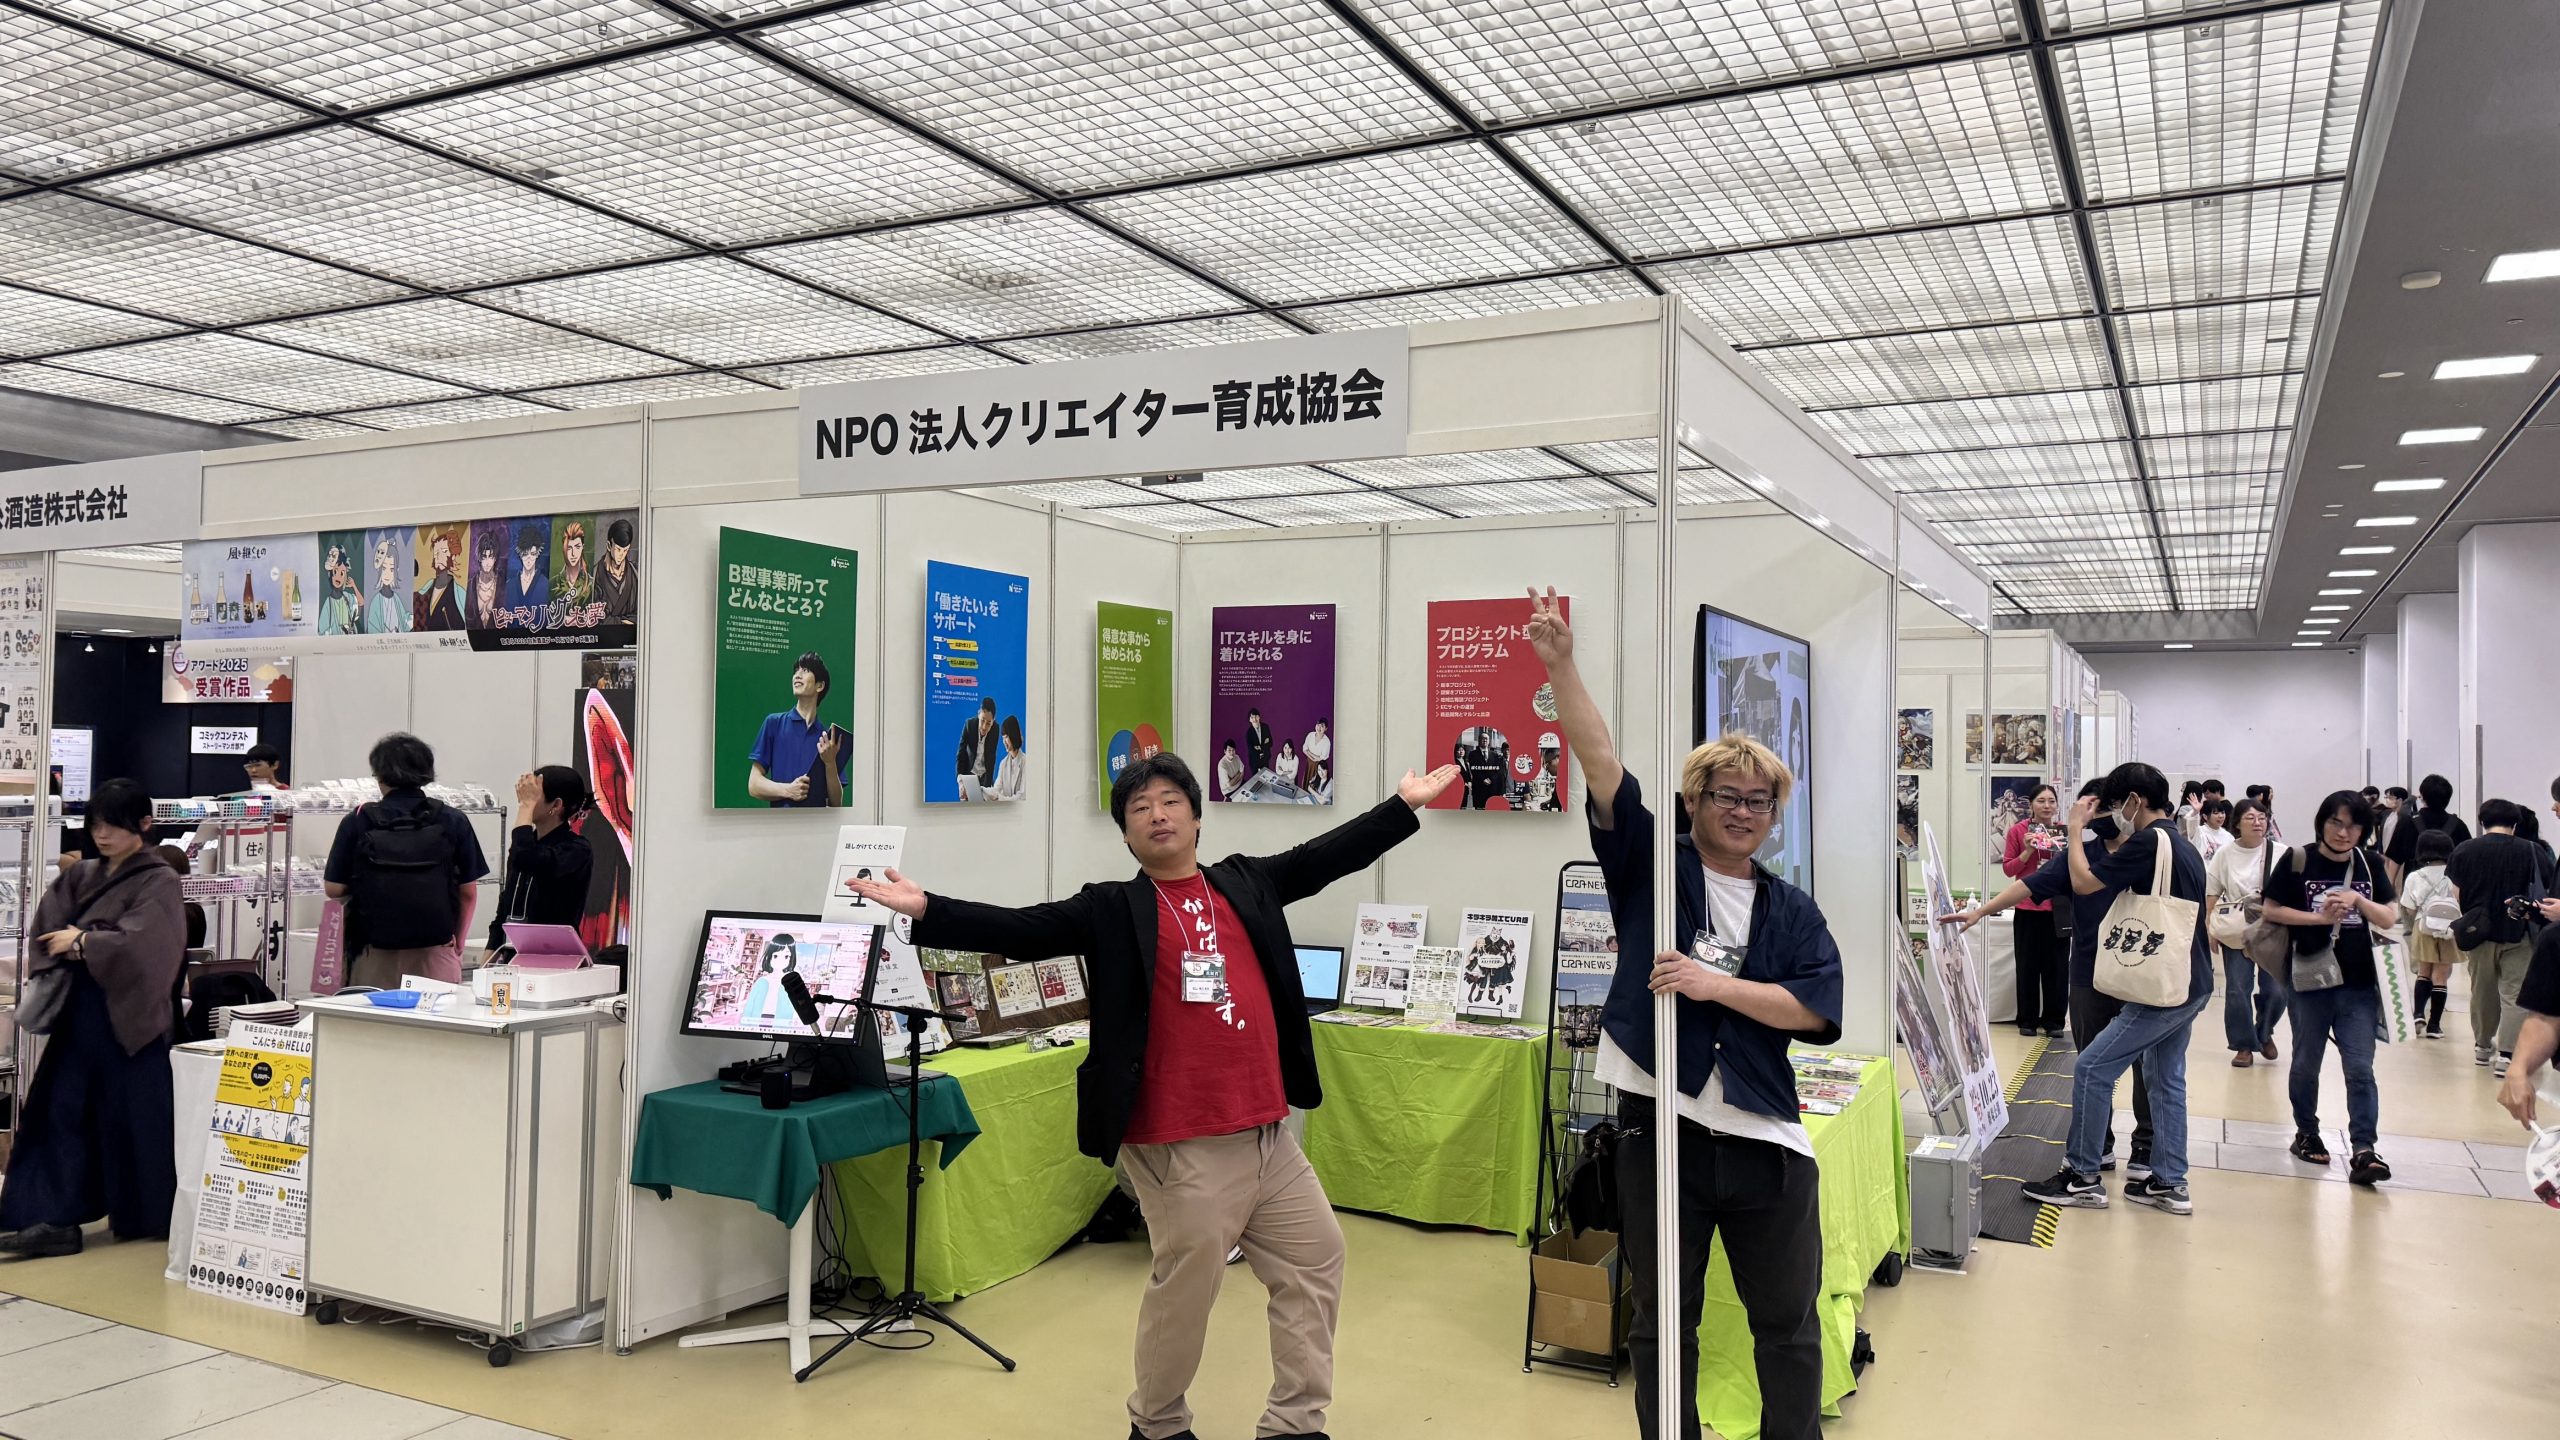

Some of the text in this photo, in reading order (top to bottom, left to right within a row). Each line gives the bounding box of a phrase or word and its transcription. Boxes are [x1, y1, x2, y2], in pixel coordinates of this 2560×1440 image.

[815, 367, 1385, 460] NPO 法人クリエイター育成協会
[0, 485, 127, 529] 酒造株式会社
[728, 563, 829, 597] B型事業所って
[934, 591, 999, 617] 「働きたい」を
[933, 612, 976, 633] サポート
[1102, 627, 1151, 647] 得意な事から
[1220, 630, 1312, 645] ITスキルを身に
[1102, 647, 1142, 663] 始められる
[1219, 647, 1283, 662] 着けられる
[1436, 643, 1509, 660] プログラム
[191, 658, 248, 672] アワード2025
[195, 676, 251, 698] 受賞作品
[199, 731, 249, 741] コミックコンテスト
[202, 742, 245, 751] ストーリーマンガ部門
[1111, 754, 1127, 771] 得意
[845, 843, 895, 851] 話しかけてください
[284, 1040, 311, 1053] HELLO
